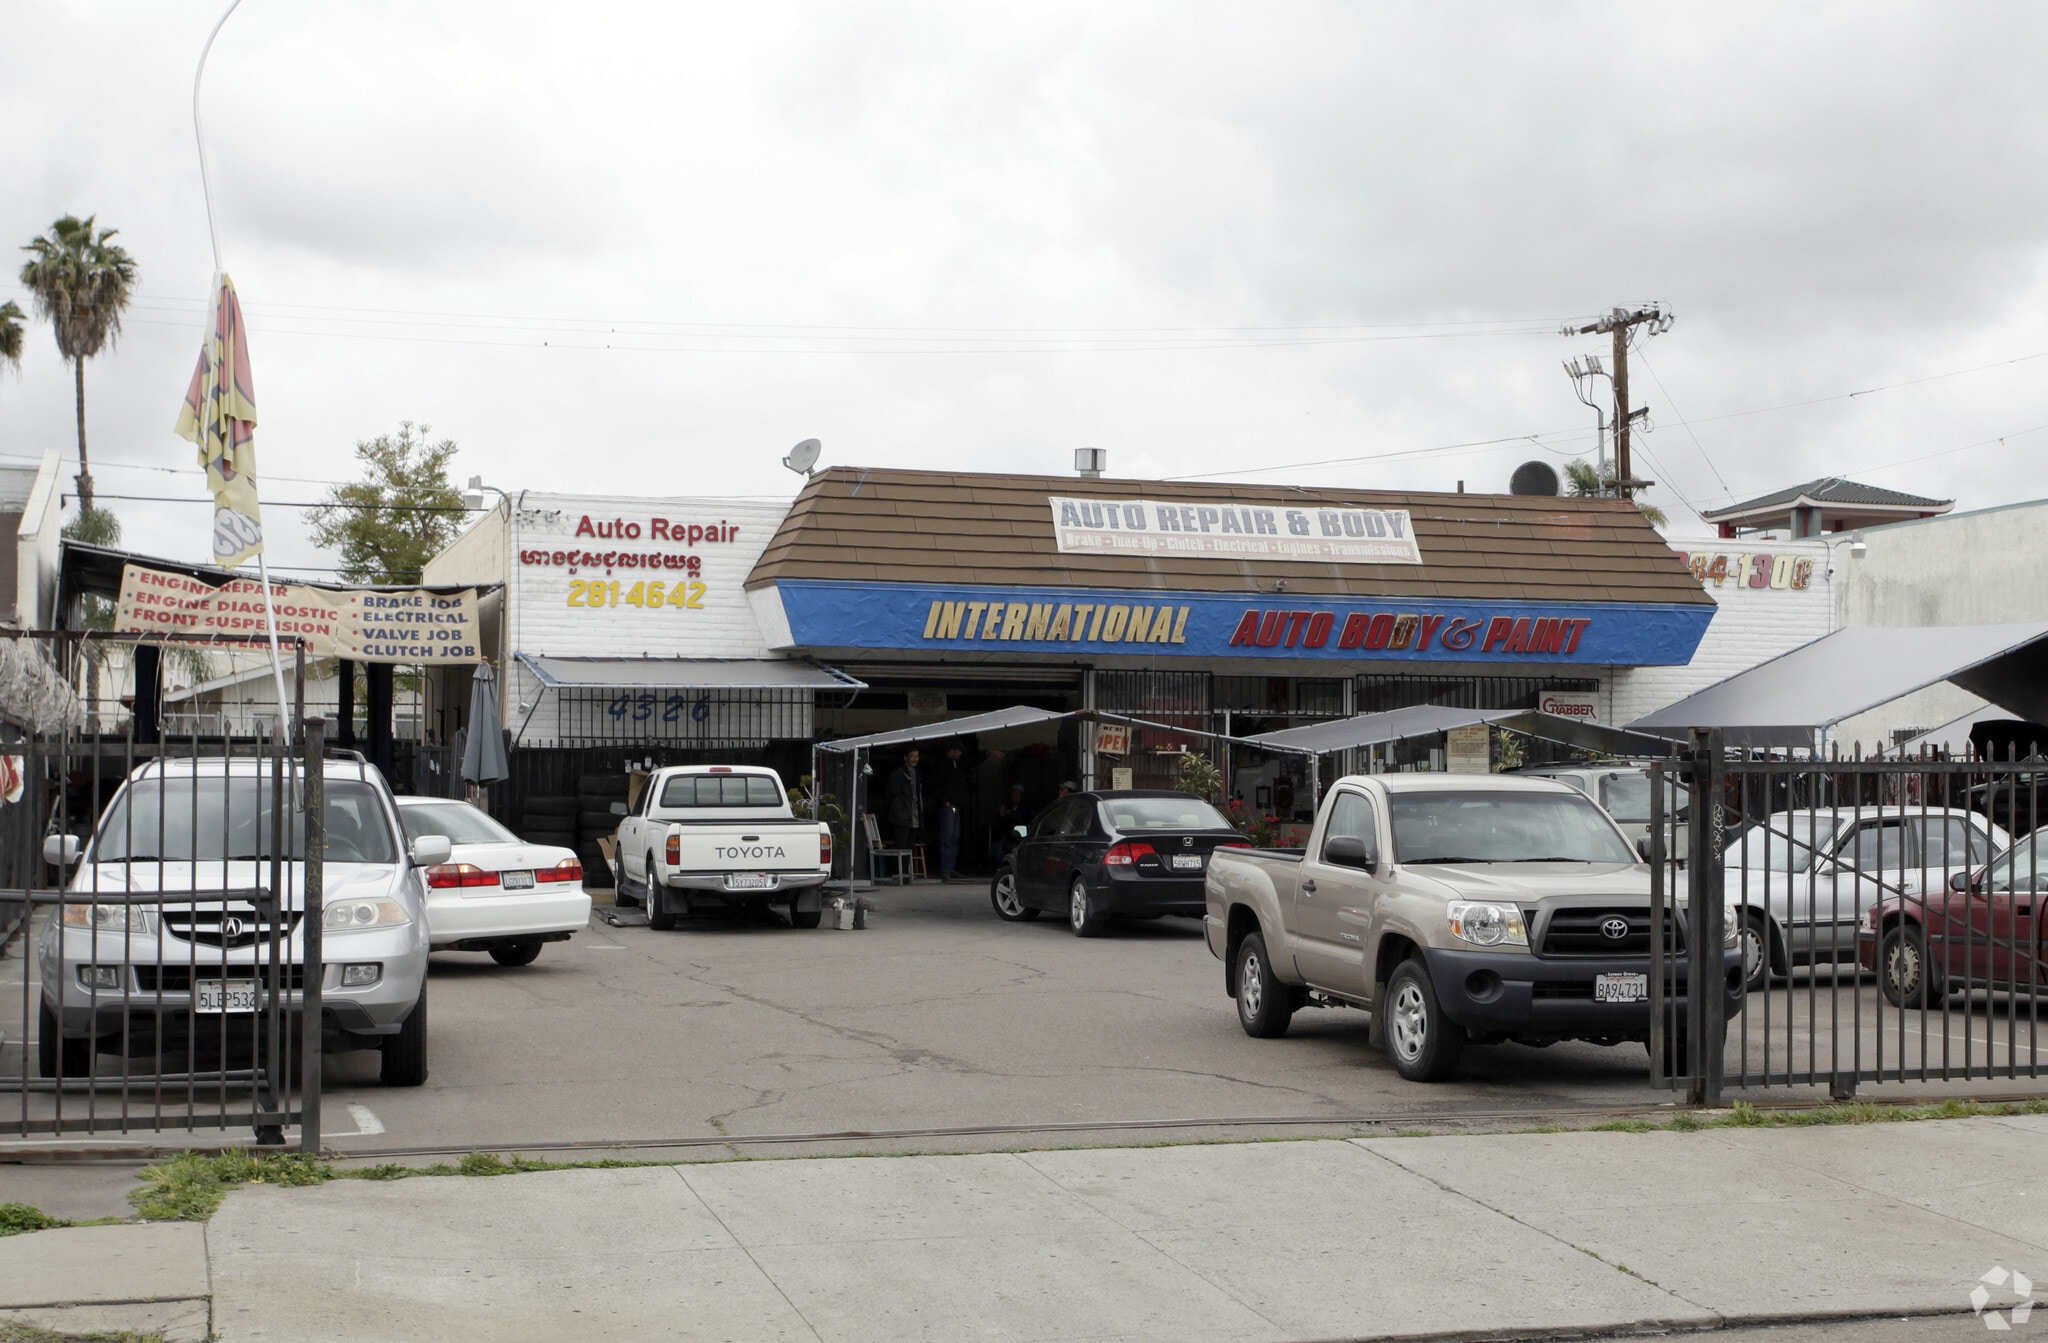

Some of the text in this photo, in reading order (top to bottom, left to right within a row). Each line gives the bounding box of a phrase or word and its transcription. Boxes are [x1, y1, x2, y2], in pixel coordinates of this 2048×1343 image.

[1061, 501, 1407, 539] AUTO REPAIR & BODY
[575, 515, 739, 546] Auto Repair
[1066, 533, 1411, 557] Brake Tune-Up Clutch Electrical Engines Transmissions
[135, 592, 210, 611] ENGINE
[363, 596, 462, 609] BRAKE JOB
[133, 608, 199, 626] FRONT
[363, 611, 468, 623] ELECTRICAL
[922, 601, 1190, 643] INTERNATIONAL
[362, 628, 463, 640] VALVE JOB
[1228, 609, 1592, 653] AUTO BODY & PAINT
[362, 644, 475, 656] CLUTCH JOB
[608, 694, 711, 721] 4326
[1543, 697, 1597, 719] GRABBER
[715, 846, 786, 859] TOYOTA
[1598, 983, 1644, 998] 8A94731
